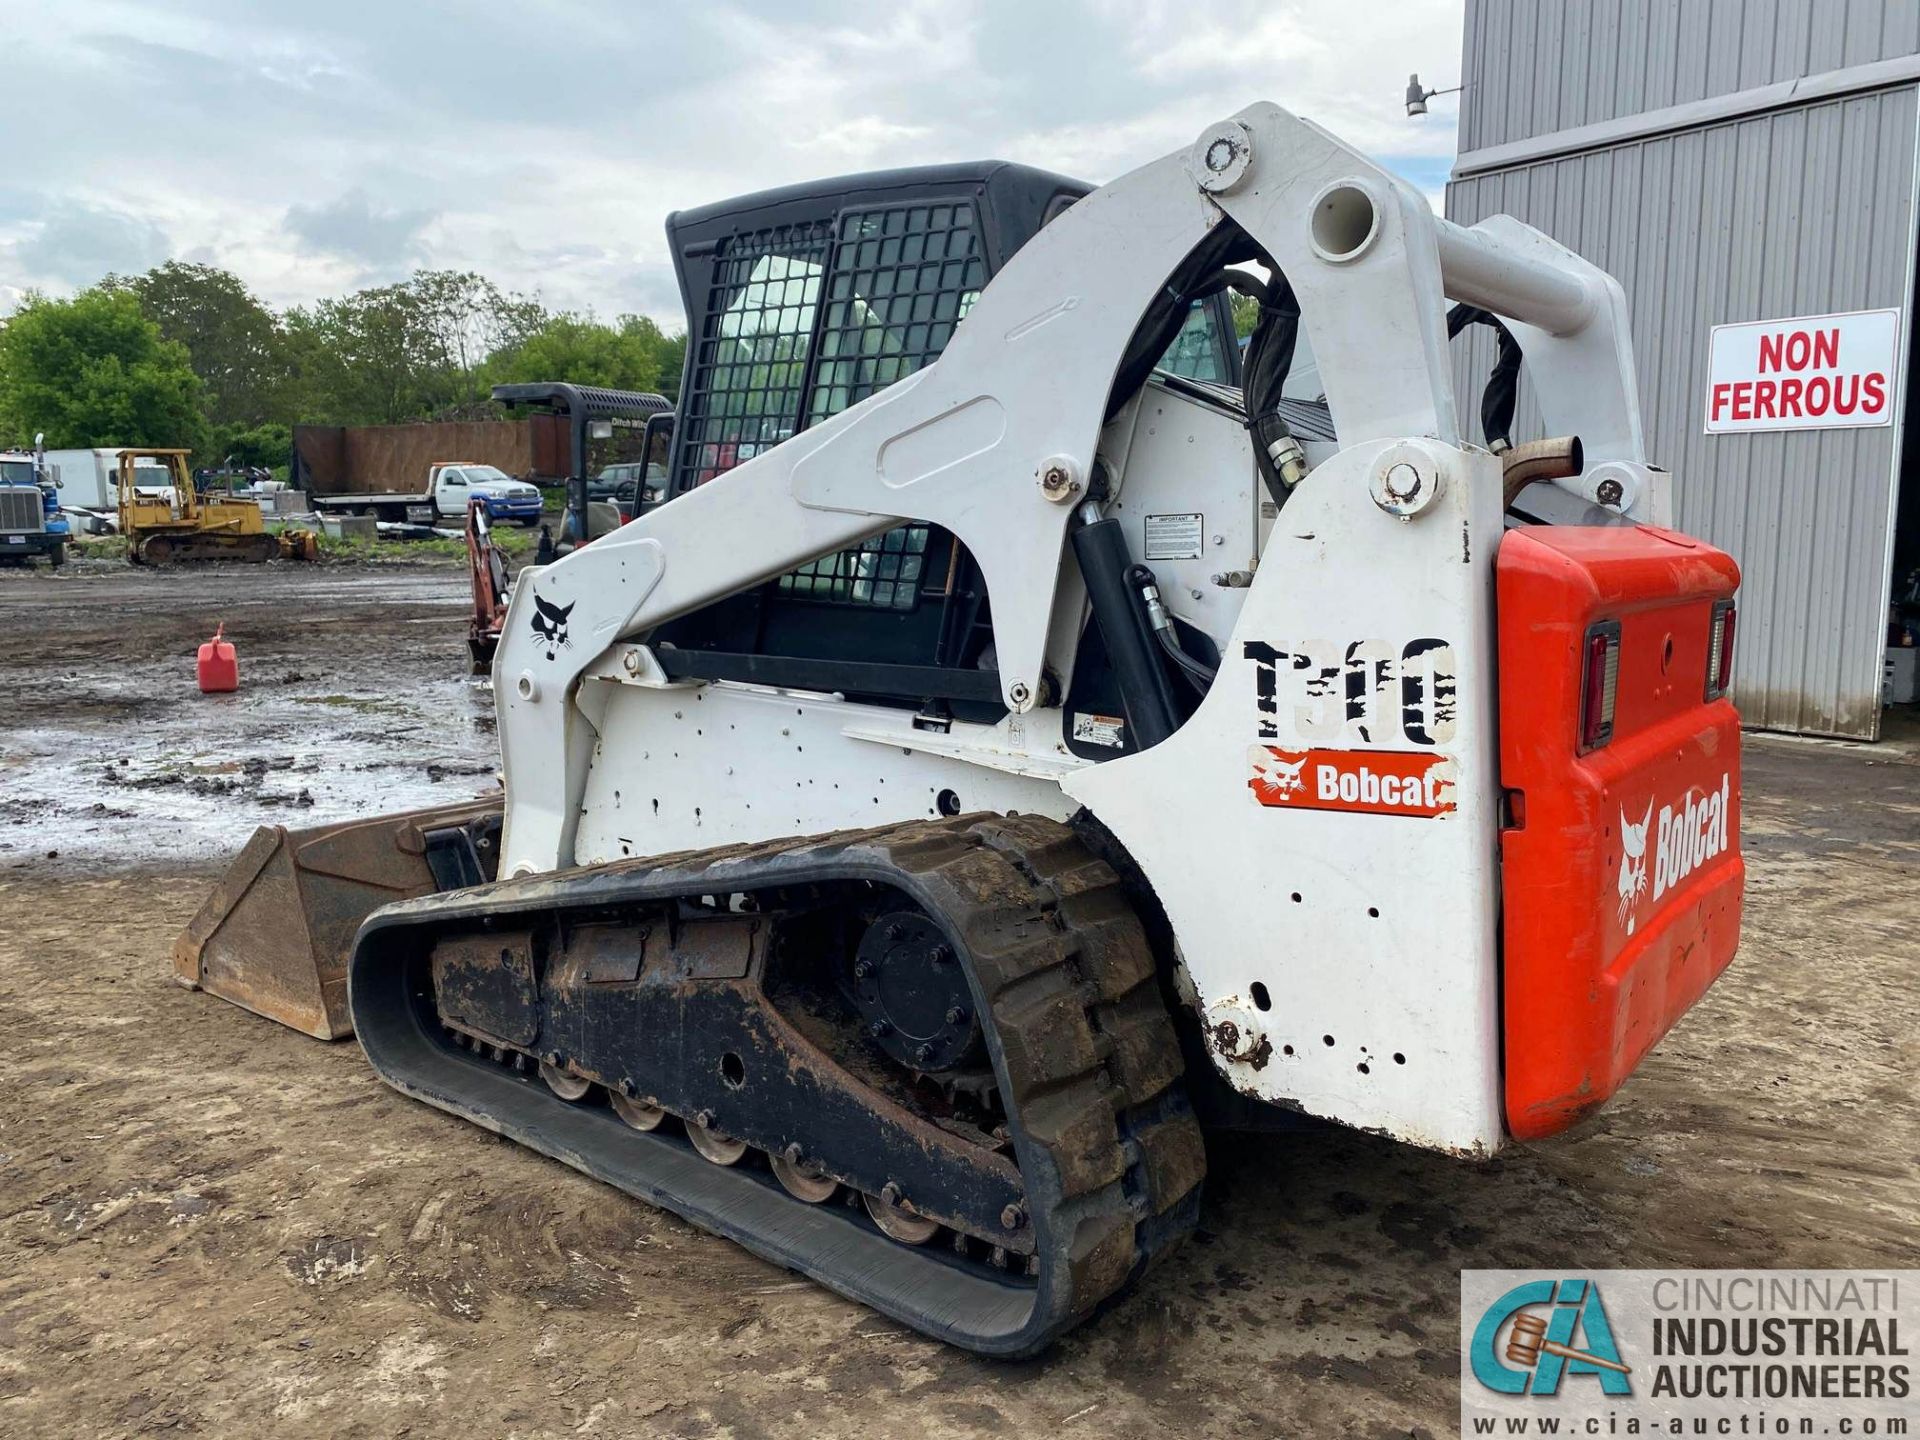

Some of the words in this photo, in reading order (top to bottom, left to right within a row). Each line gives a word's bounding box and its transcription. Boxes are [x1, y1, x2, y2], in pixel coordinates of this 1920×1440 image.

[1758, 328, 1840, 374] NON
[1711, 373, 1886, 421] FERROUS
[1243, 638, 1457, 746] T300
[1316, 764, 1437, 808] Bobcat
[1652, 772, 1730, 903] Bobcat
